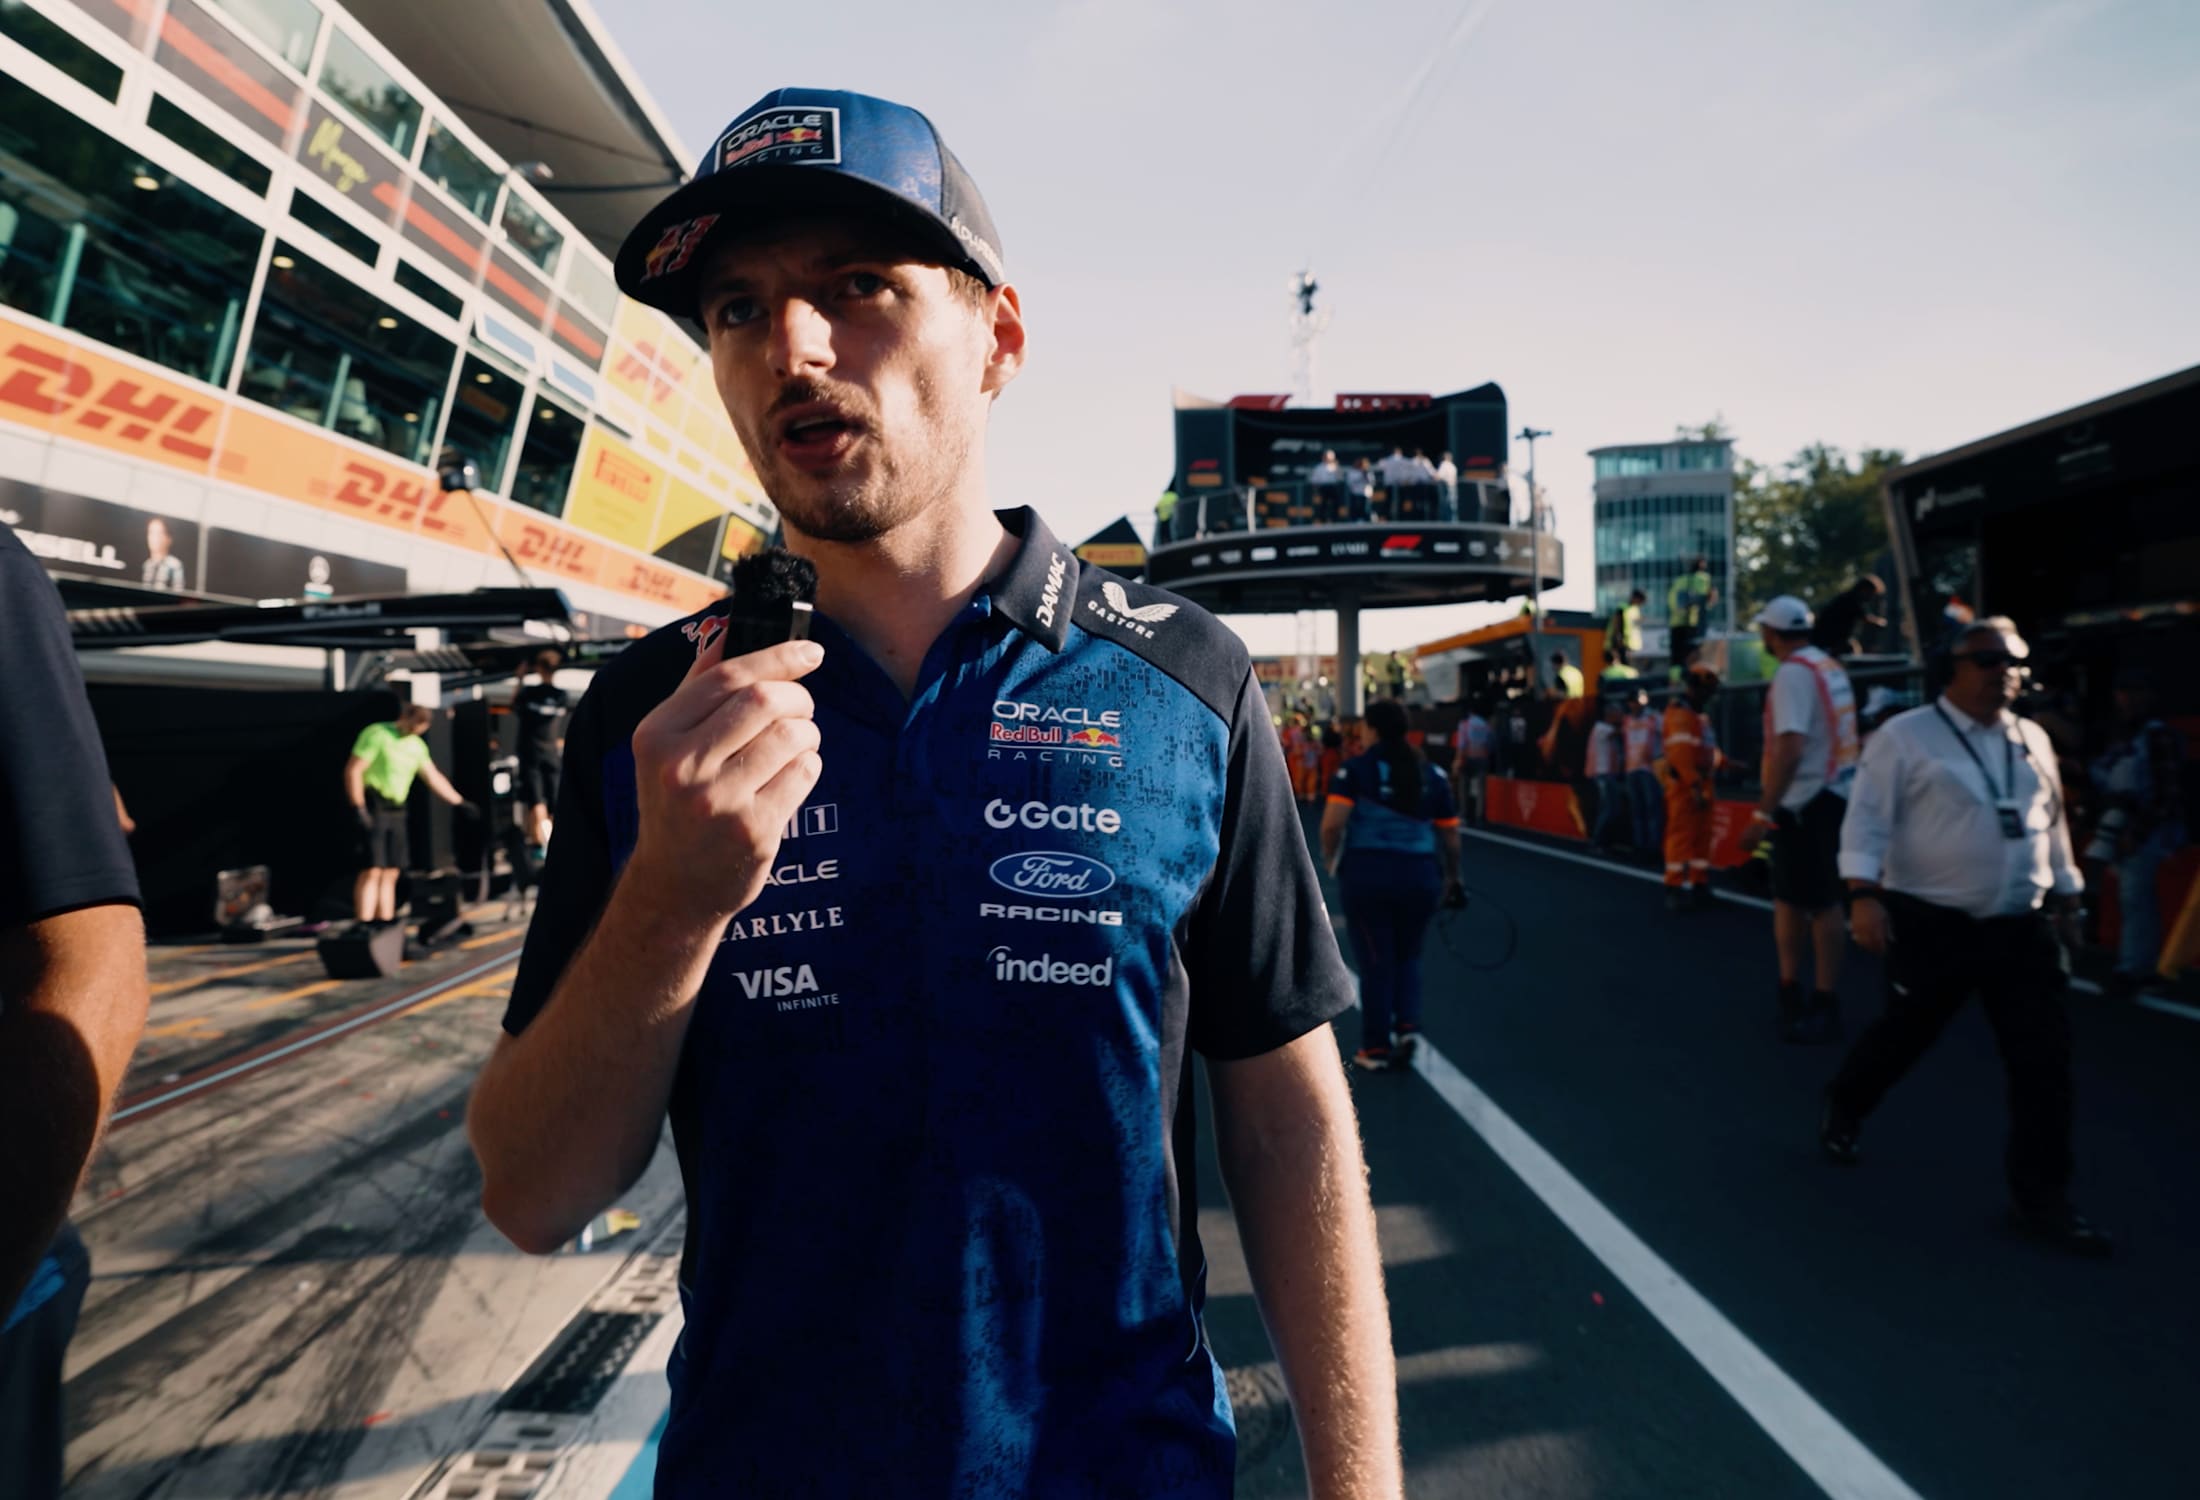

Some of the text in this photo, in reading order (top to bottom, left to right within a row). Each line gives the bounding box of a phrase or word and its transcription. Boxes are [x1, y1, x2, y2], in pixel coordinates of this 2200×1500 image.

[727, 114, 822, 149] ORACLE
[743, 145, 823, 166] CING
[0, 343, 215, 462] DHL
[336, 461, 450, 531] DHL
[516, 525, 584, 573] DHL
[1035, 552, 1067, 628] DAMAC
[1087, 600, 1156, 639] CASTORE
[993, 700, 1122, 728] ORACLE
[987, 750, 1123, 768] RACING
[765, 859, 840, 886] ACLE
[1013, 856, 1093, 891] Ford
[979, 903, 1123, 926] RACING
[731, 964, 820, 1000] VISA
[995, 951, 1113, 987] indeed
[777, 993, 840, 1012] INFINITE
